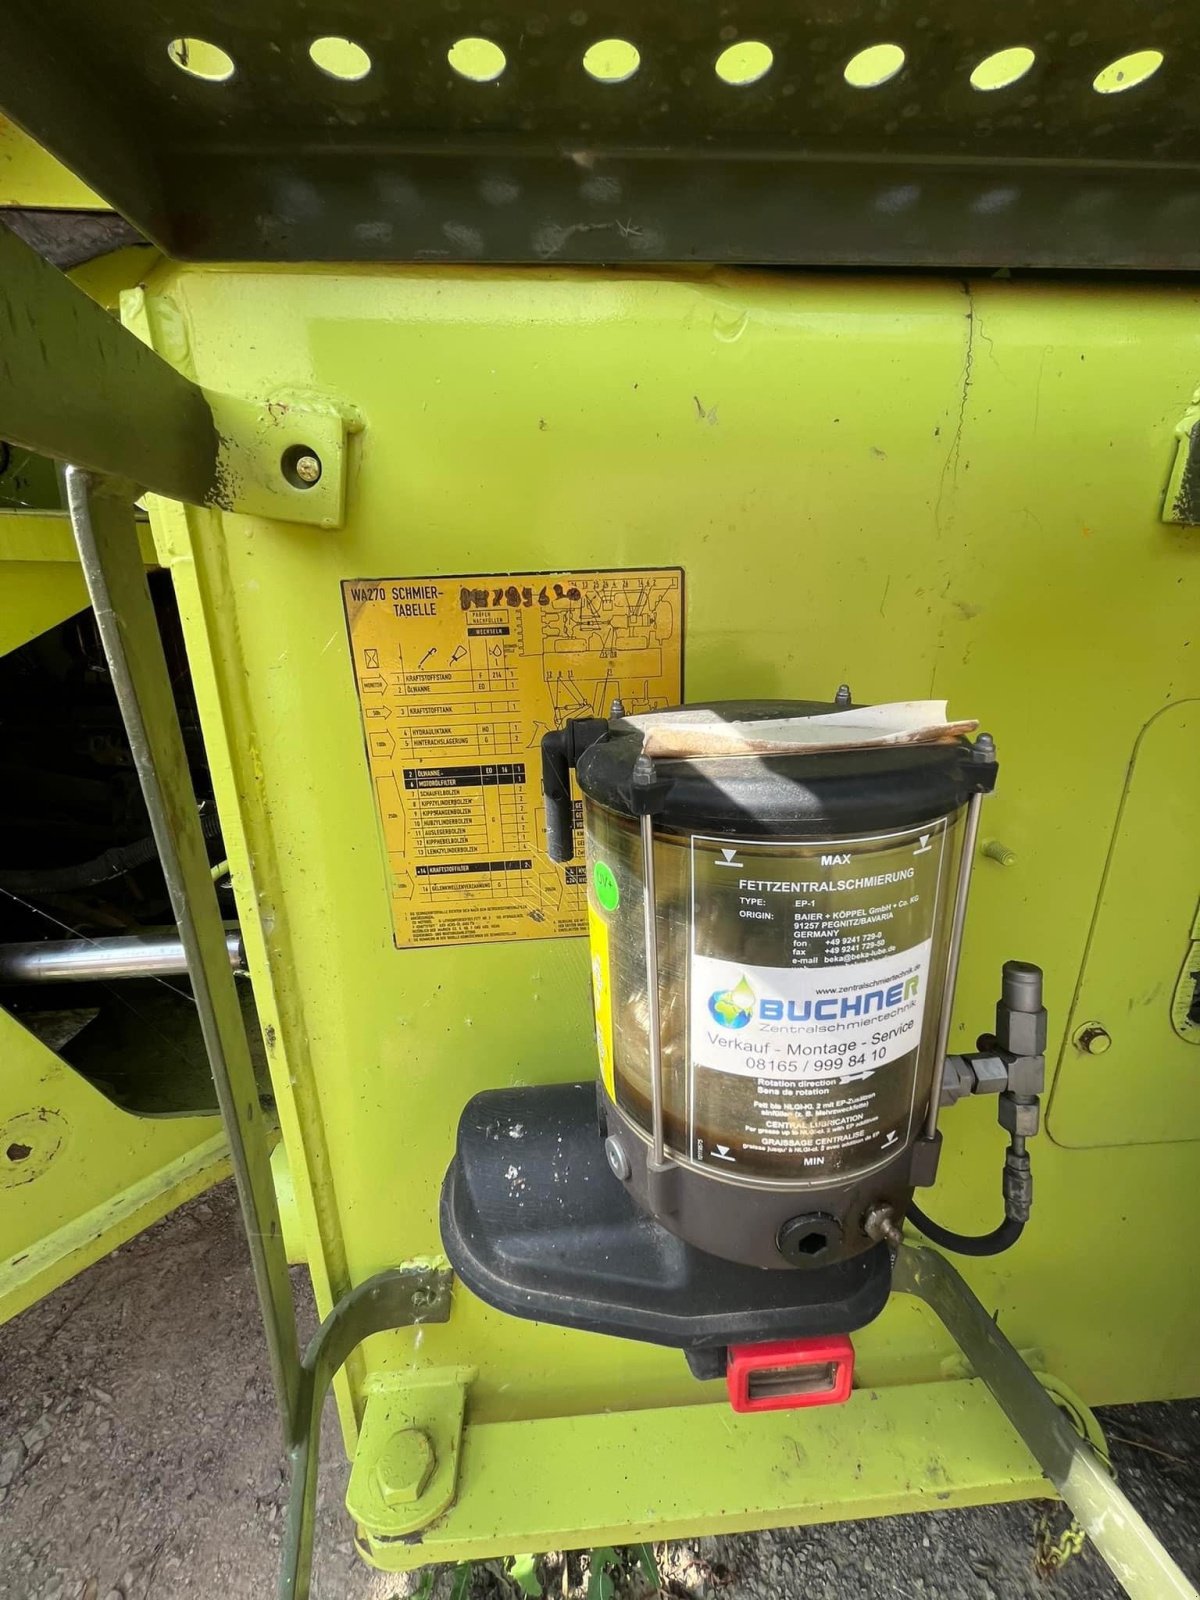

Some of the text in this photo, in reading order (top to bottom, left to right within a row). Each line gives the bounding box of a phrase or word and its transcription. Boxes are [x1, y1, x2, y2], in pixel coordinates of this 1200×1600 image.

[351, 586, 444, 601] WA270 SCHMIER-
[393, 603, 437, 616] TABELLE
[406, 673, 452, 682] KRAFTSTOFFSTAND
[410, 706, 452, 714] KRAFTSTOFFTANK
[412, 728, 452, 736] HYDRAULIKTANK
[414, 738, 468, 746] HINTERACHSLAGERUNG
[419, 779, 457, 787] MOTORÖLFILTER
[421, 799, 472, 807] KIPPZYLINDERBOLZEN
[424, 818, 473, 826] HUBZYLINDERBOLZEN
[427, 846, 478, 855] LENKZYLINDERBOLZEN
[821, 854, 851, 866] MAX
[739, 868, 914, 892] FETTZENTRALSCHMIERUNG
[432, 883, 490, 892] GELENKWELLENVERZAHNUNG
[739, 897, 766, 906] TYPE:
[739, 910, 774, 920] ORIGIN:
[832, 910, 867, 919] KÖPPEL
[869, 904, 892, 915] GmbH
[910, 895, 919, 903] KG
[822, 912, 894, 929] PEGNITZ/BAVARIA
[794, 930, 840, 938] GERMANY
[842, 935, 860, 944] 9241
[862, 931, 882, 942] 729-0
[842, 944, 859, 953] 9241
[824, 946, 896, 964] beka@beka-lube.de
[816, 963, 921, 995] www.zentralschmiertechnik.de
[759, 974, 919, 1021] BUCHNER
[760, 1000, 916, 1034] Zentralschmiertechnik
[707, 1032, 771, 1054] Verkauf
[787, 1040, 857, 1057] Montage
[871, 1019, 914, 1046] Service
[746, 1047, 887, 1072] 08165 / 999 84 10
[758, 1079, 836, 1088] Rotation direction
[766, 1113, 864, 1129] CENTRAL LUBRICATION
[761, 1130, 865, 1146] GRAISSAGE CENTRALISE
[804, 1157, 825, 1166] MIN
